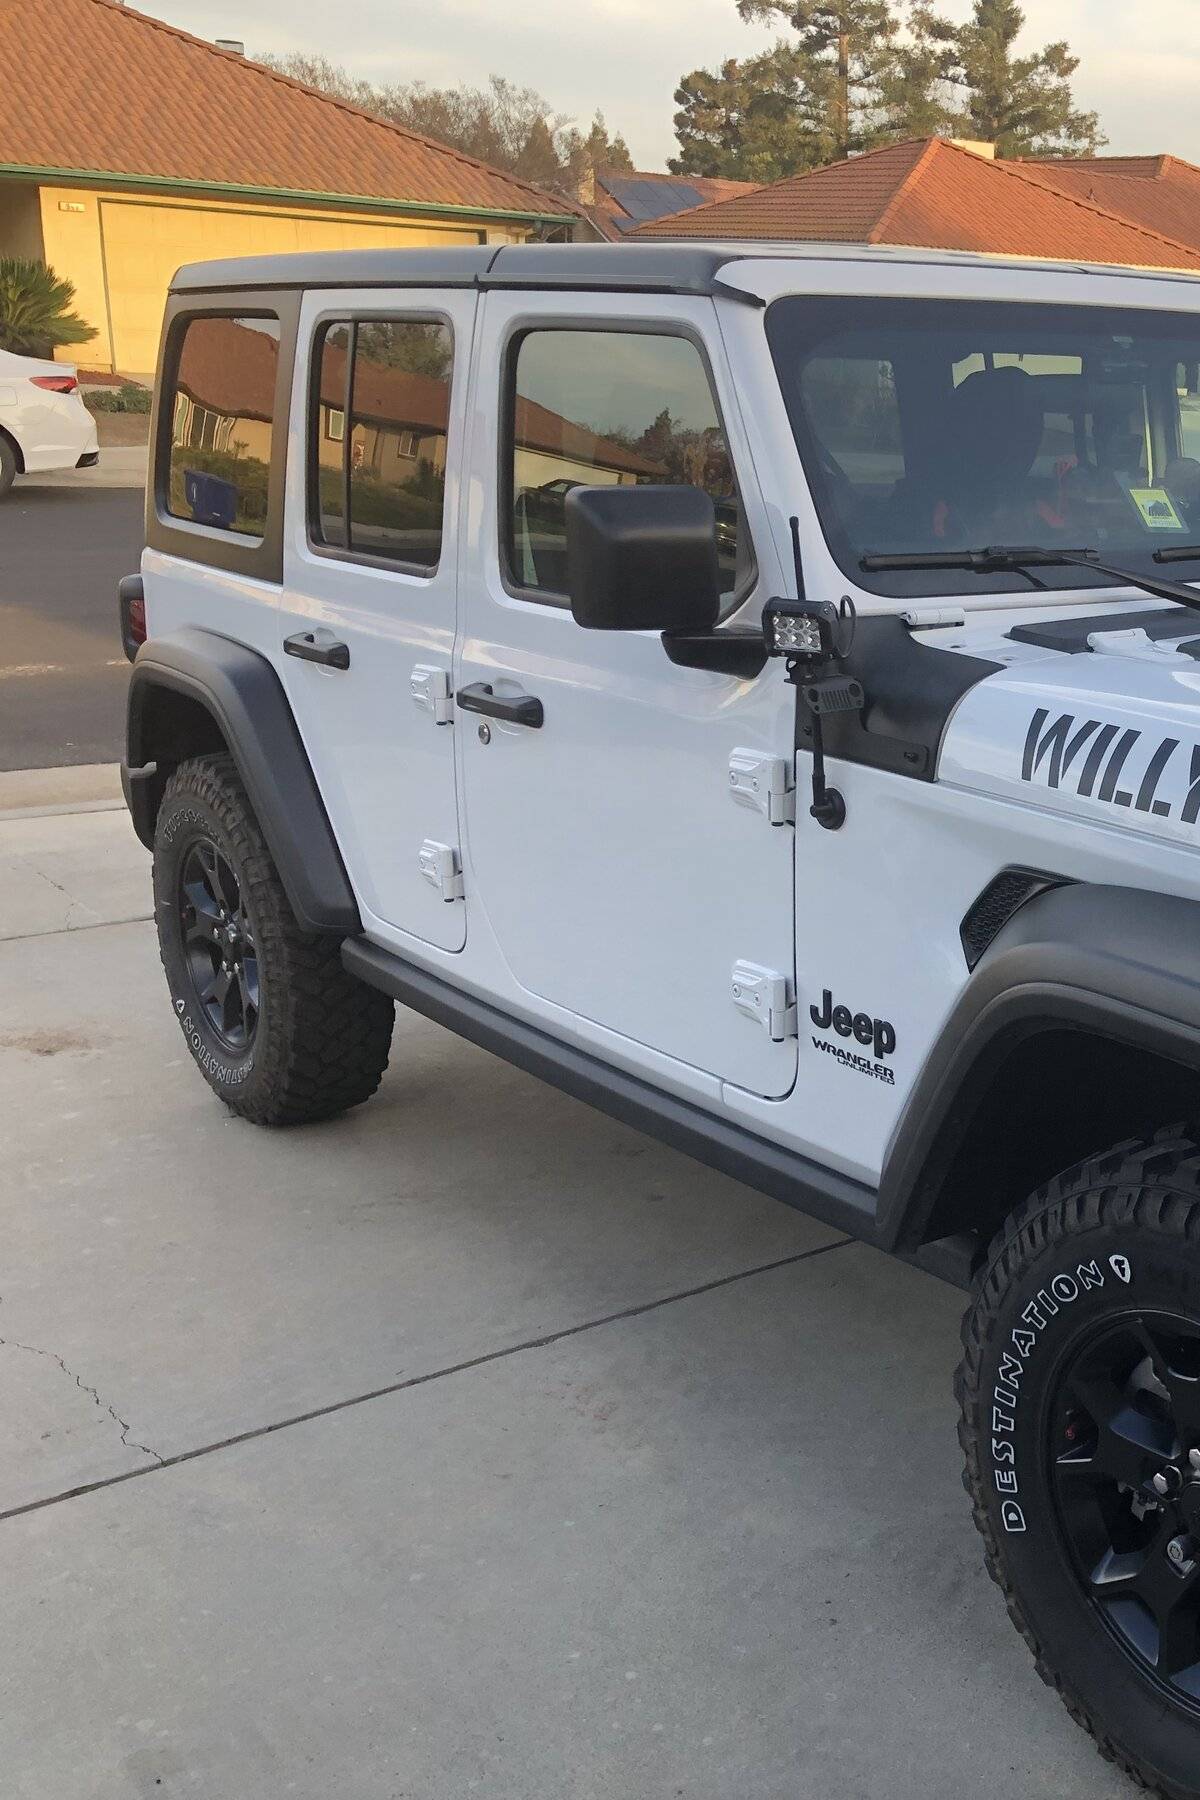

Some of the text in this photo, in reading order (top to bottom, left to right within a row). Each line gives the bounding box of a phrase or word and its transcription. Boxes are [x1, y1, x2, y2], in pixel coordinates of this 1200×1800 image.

[809, 988, 896, 1060] Jeep
[811, 1036, 895, 1081] WRANGLER
[837, 1057, 896, 1086] UNLIMITED
[992, 1259, 1105, 1532] DESTINATION
